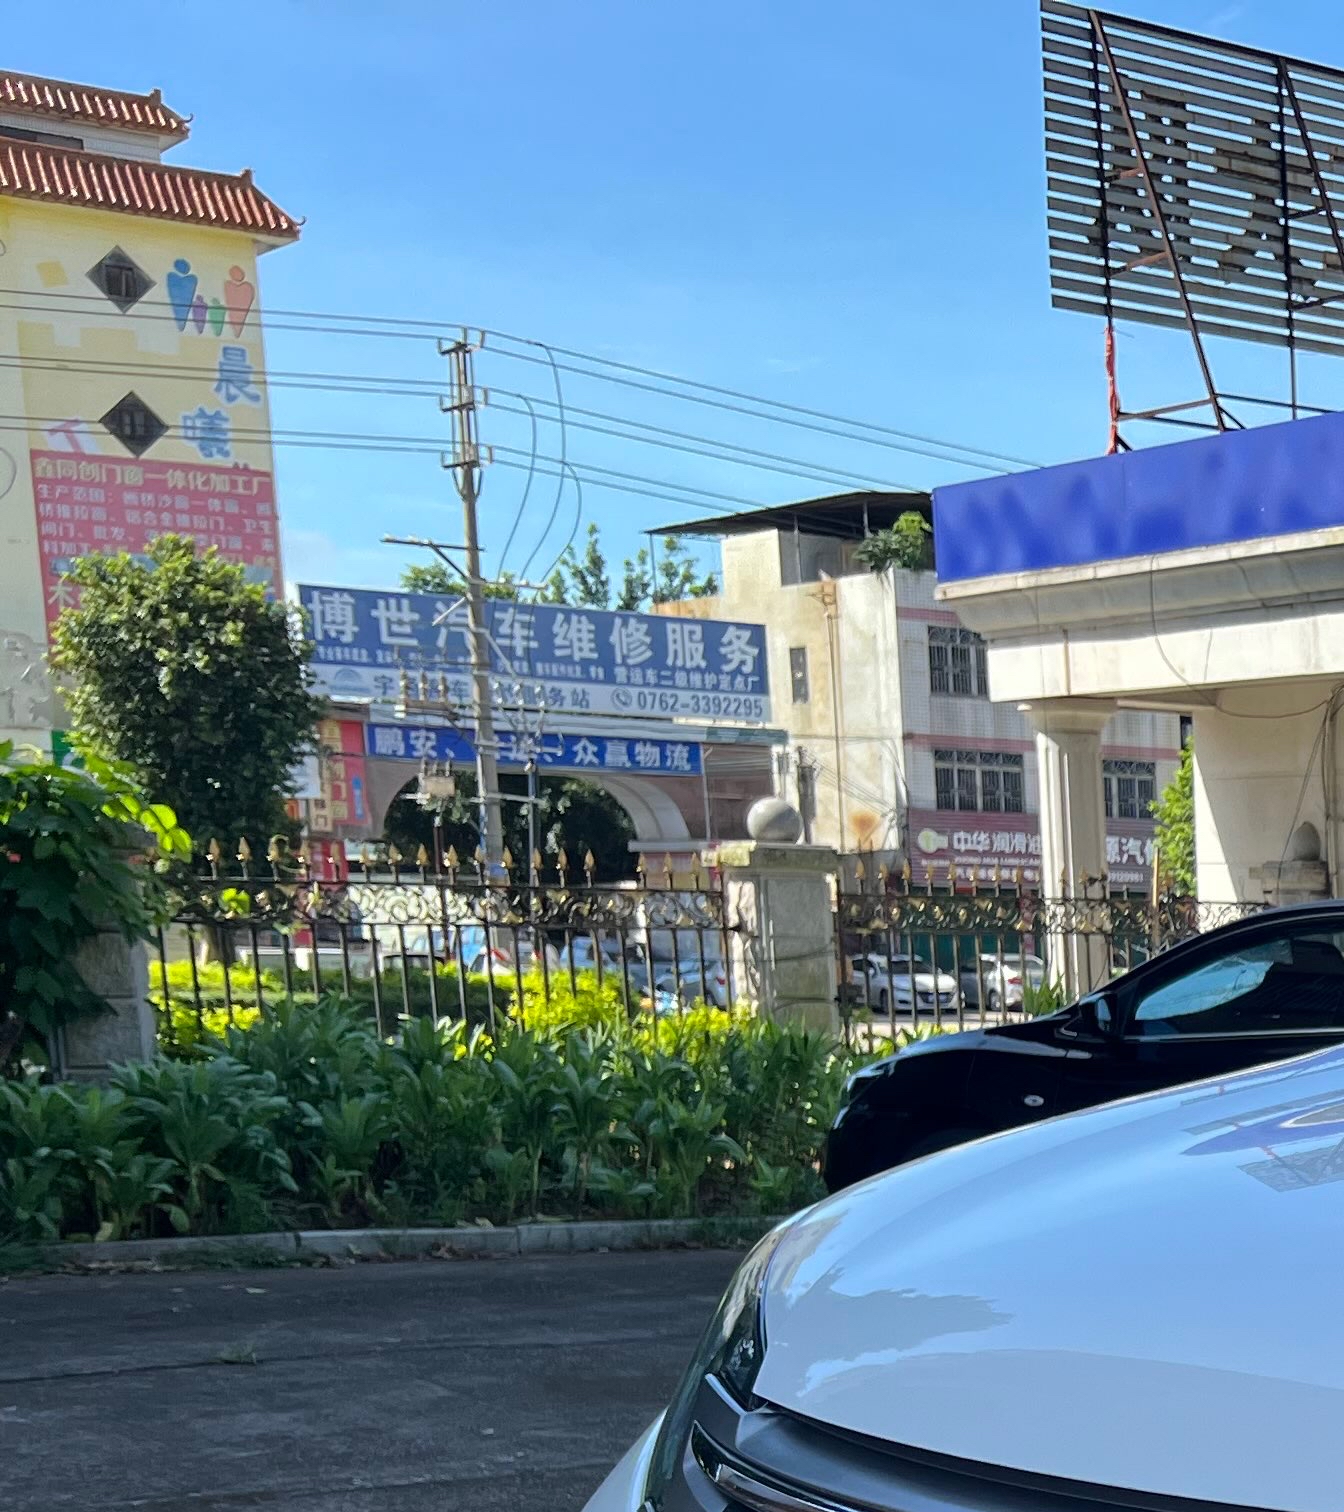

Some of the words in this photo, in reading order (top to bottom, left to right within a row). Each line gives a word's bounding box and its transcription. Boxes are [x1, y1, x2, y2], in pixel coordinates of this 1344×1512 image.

[308, 590, 759, 674] 博世汽车维修服务
[637, 692, 763, 717] 0762-3392295
